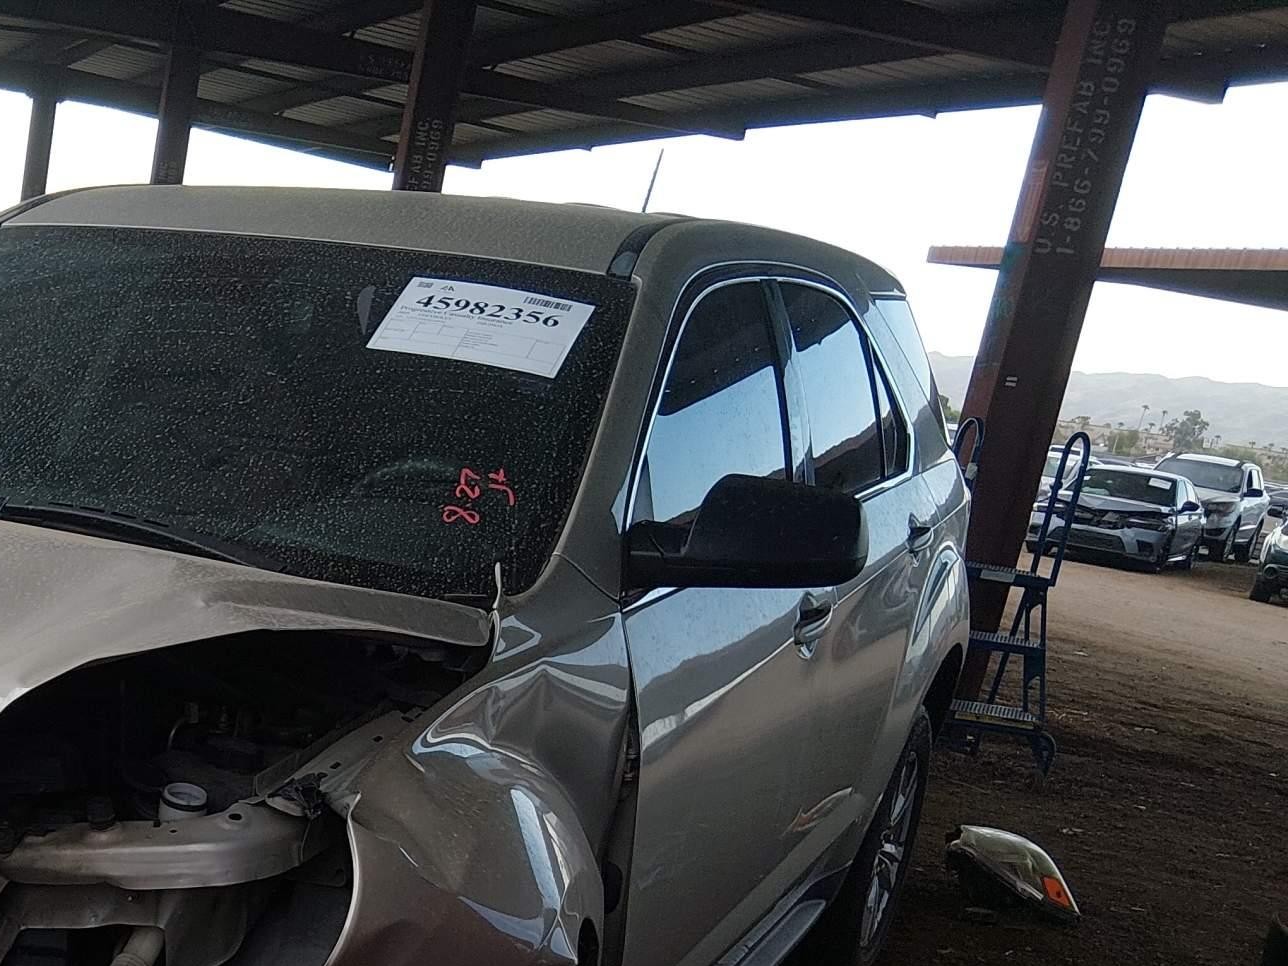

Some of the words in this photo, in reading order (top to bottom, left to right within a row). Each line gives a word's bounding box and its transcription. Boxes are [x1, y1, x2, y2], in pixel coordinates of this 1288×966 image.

[1052, 80, 1096, 187] PREFAB
[1055, 18, 1137, 254] 1-866-799-0969
[415, 294, 562, 328] 45982356
